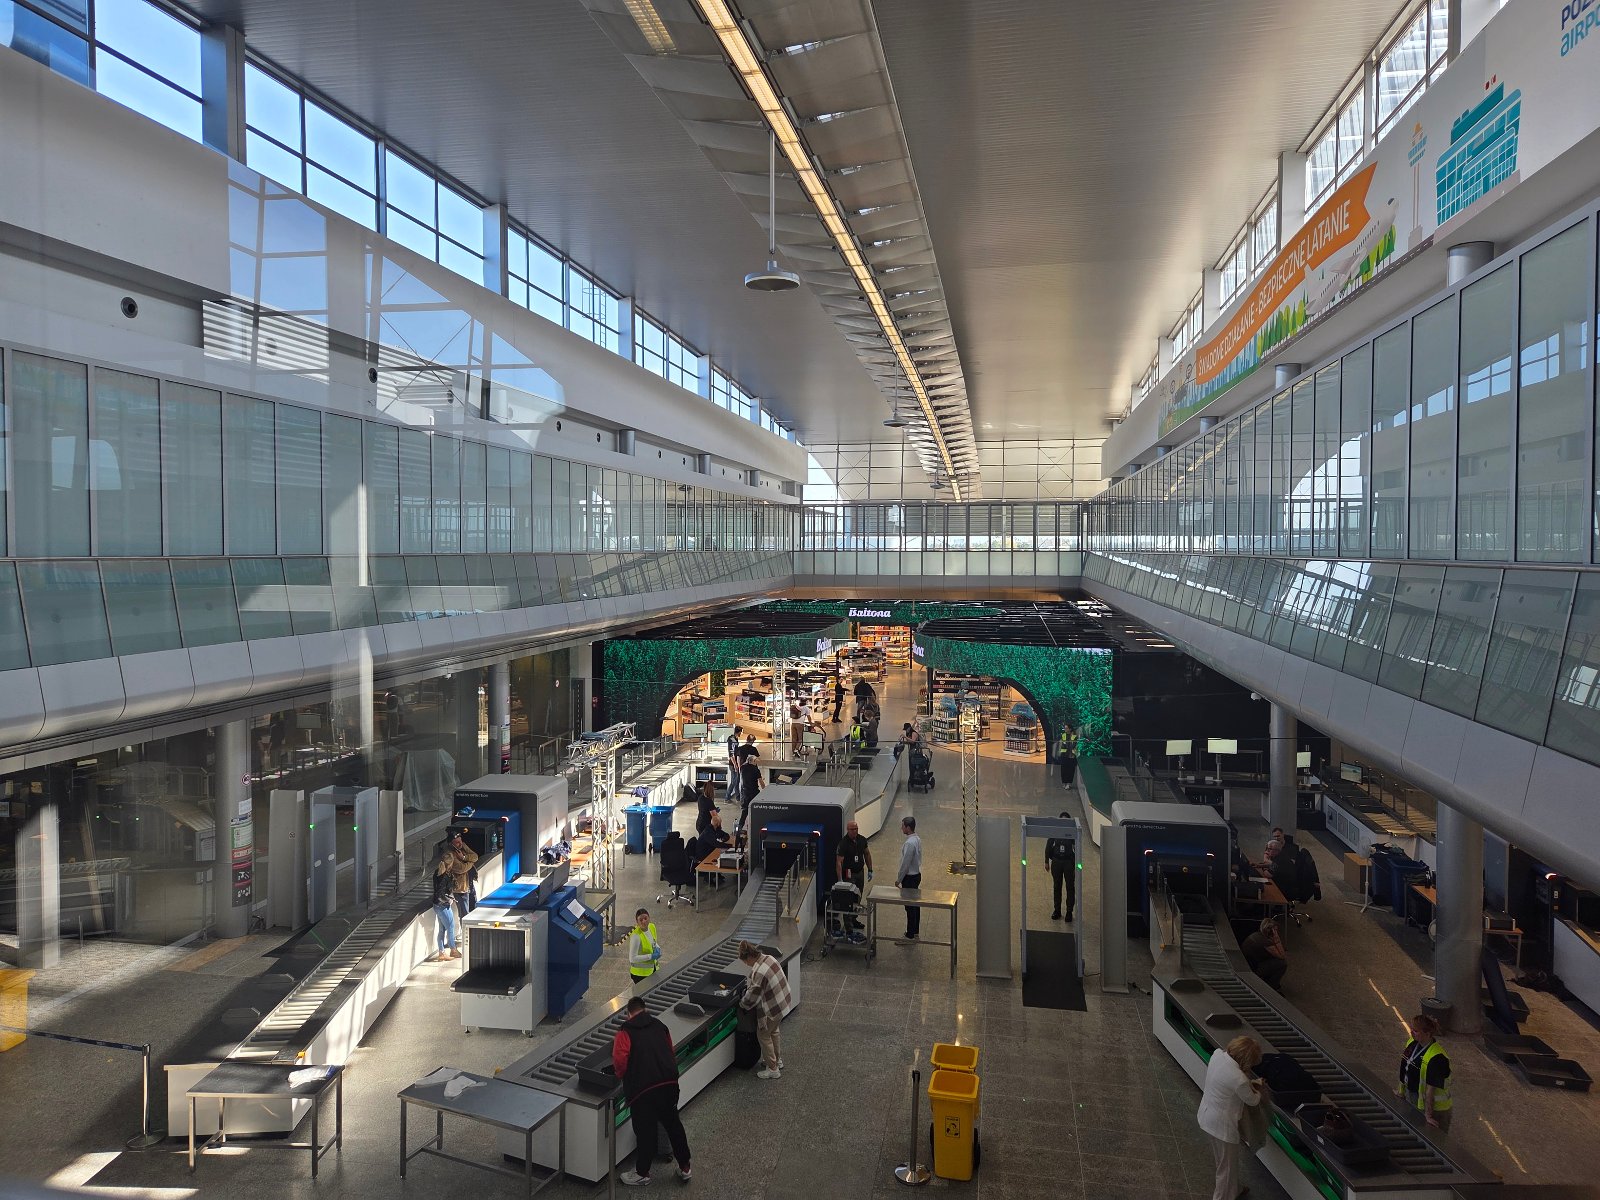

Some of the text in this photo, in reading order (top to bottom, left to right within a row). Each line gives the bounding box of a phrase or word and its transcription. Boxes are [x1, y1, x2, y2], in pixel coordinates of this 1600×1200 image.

[1198, 340, 1224, 377] ŚWIADOME
[1224, 302, 1255, 356] DZIAŁANIE
[1258, 240, 1306, 314] BEZPIECZNE
[1307, 200, 1350, 260] LATANIE
